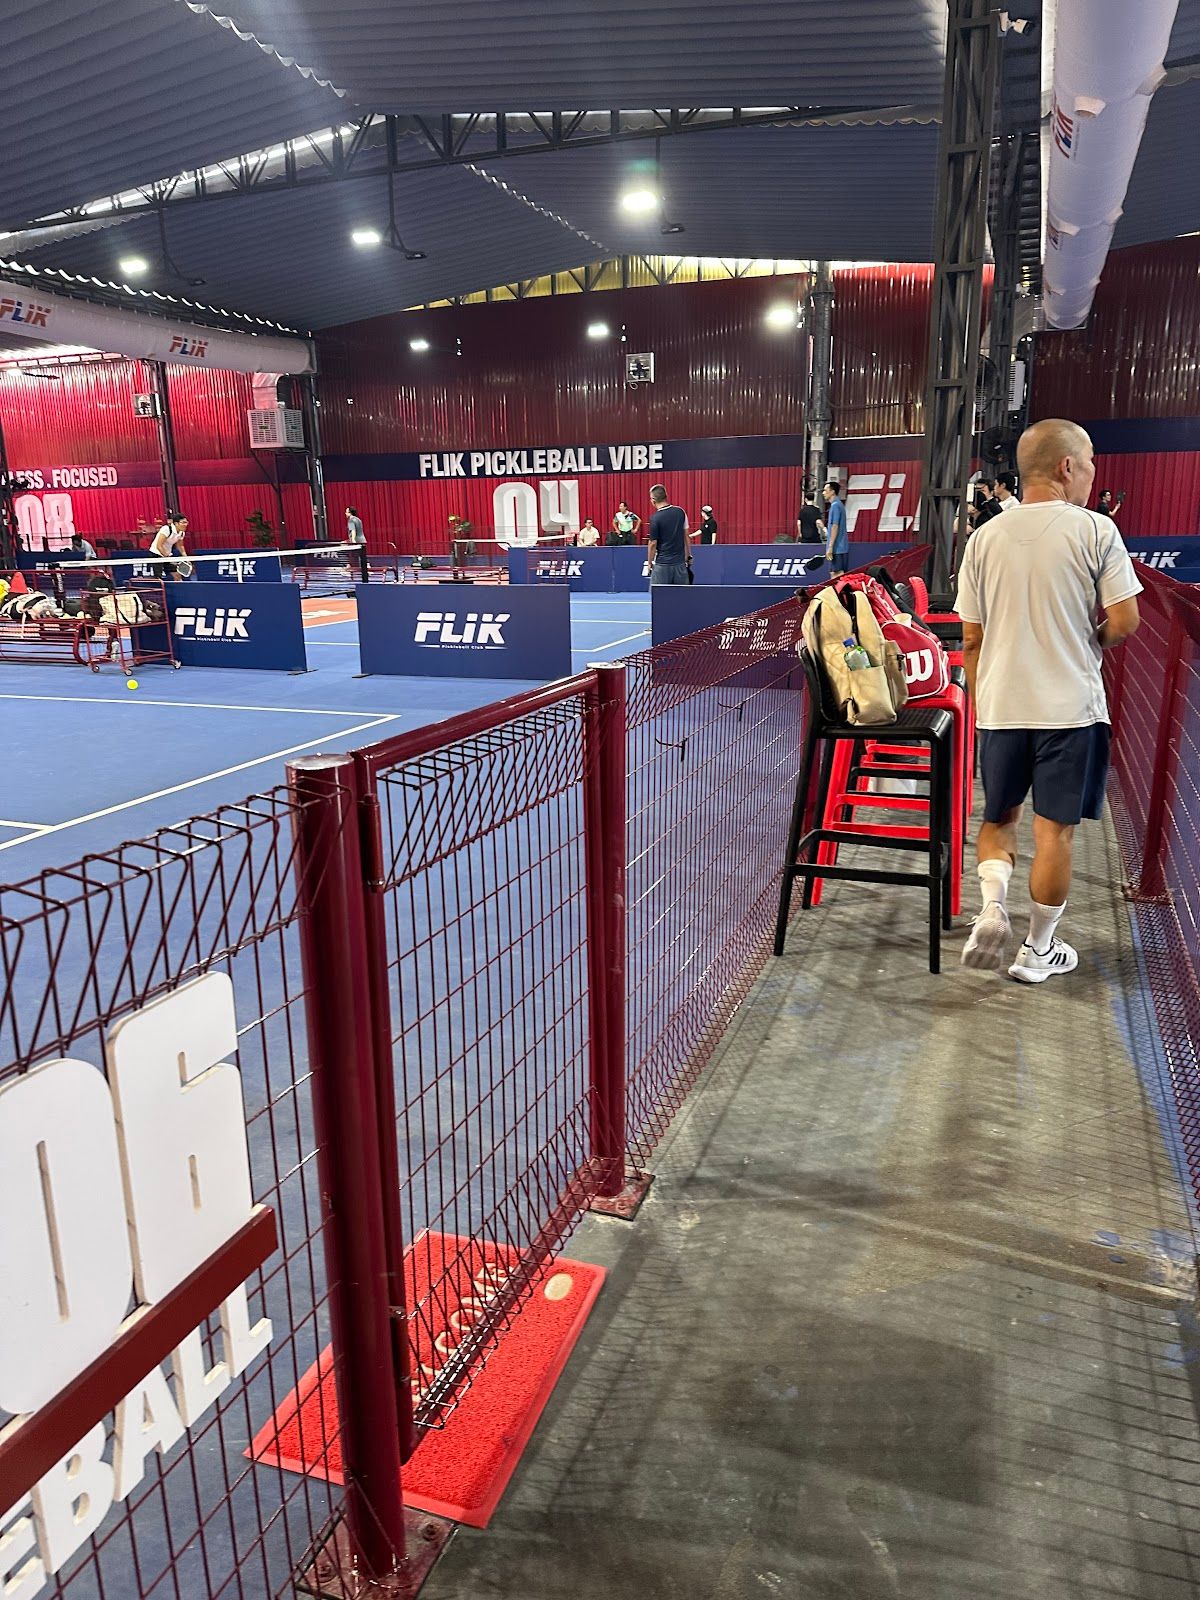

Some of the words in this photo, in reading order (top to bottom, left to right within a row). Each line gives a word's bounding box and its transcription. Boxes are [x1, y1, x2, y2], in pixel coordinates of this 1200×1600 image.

[0, 298, 52, 327] FLIK
[169, 335, 209, 358] FLIK
[419, 453, 466, 478] FLIK
[471, 447, 604, 477] PICKLEBALL
[608, 444, 663, 471] VIBE
[15, 492, 76, 552] 08
[493, 480, 580, 550] 04
[755, 559, 808, 576] FLIK
[174, 607, 252, 637] FLIK
[414, 612, 511, 644] FLIK
[0, 971, 253, 1414] 06
